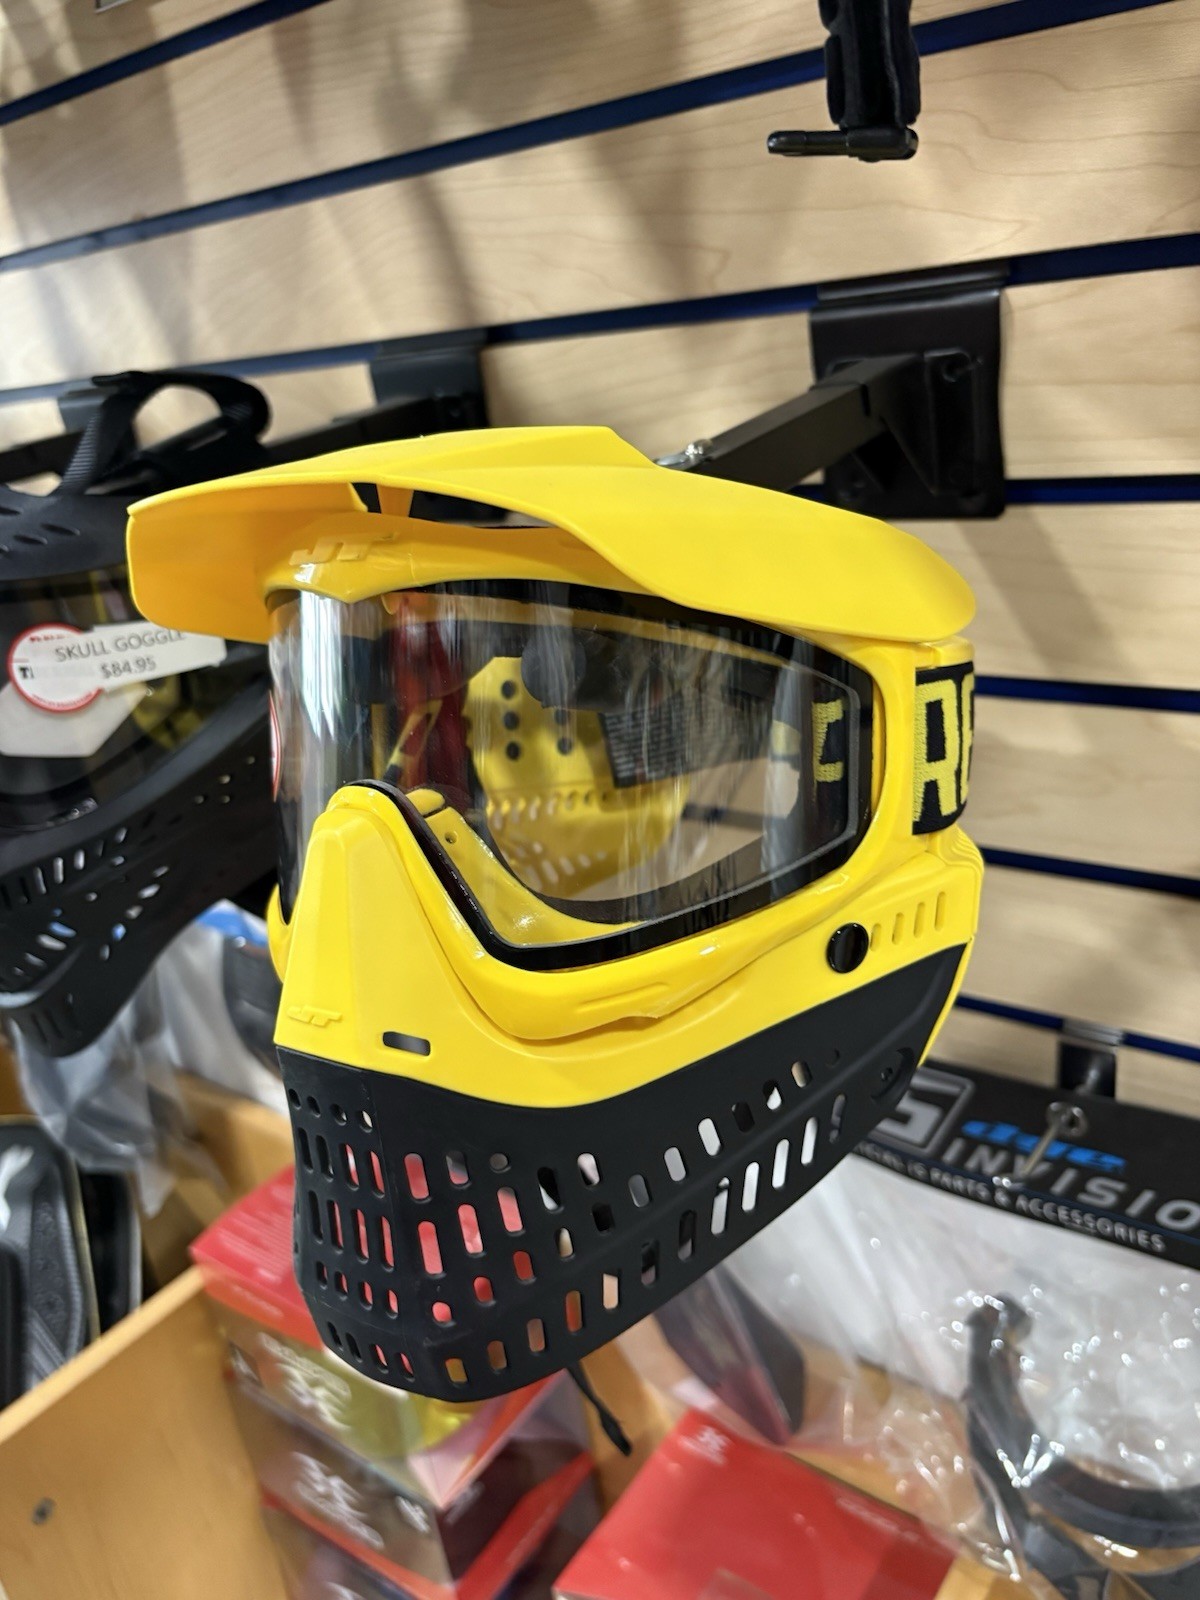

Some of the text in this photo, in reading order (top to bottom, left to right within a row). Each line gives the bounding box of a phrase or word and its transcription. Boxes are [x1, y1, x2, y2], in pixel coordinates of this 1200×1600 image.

[54, 639, 112, 663] SKULL
[100, 656, 157, 680] $84.95
[1015, 1194, 1167, 1253] ACCESSORIES
